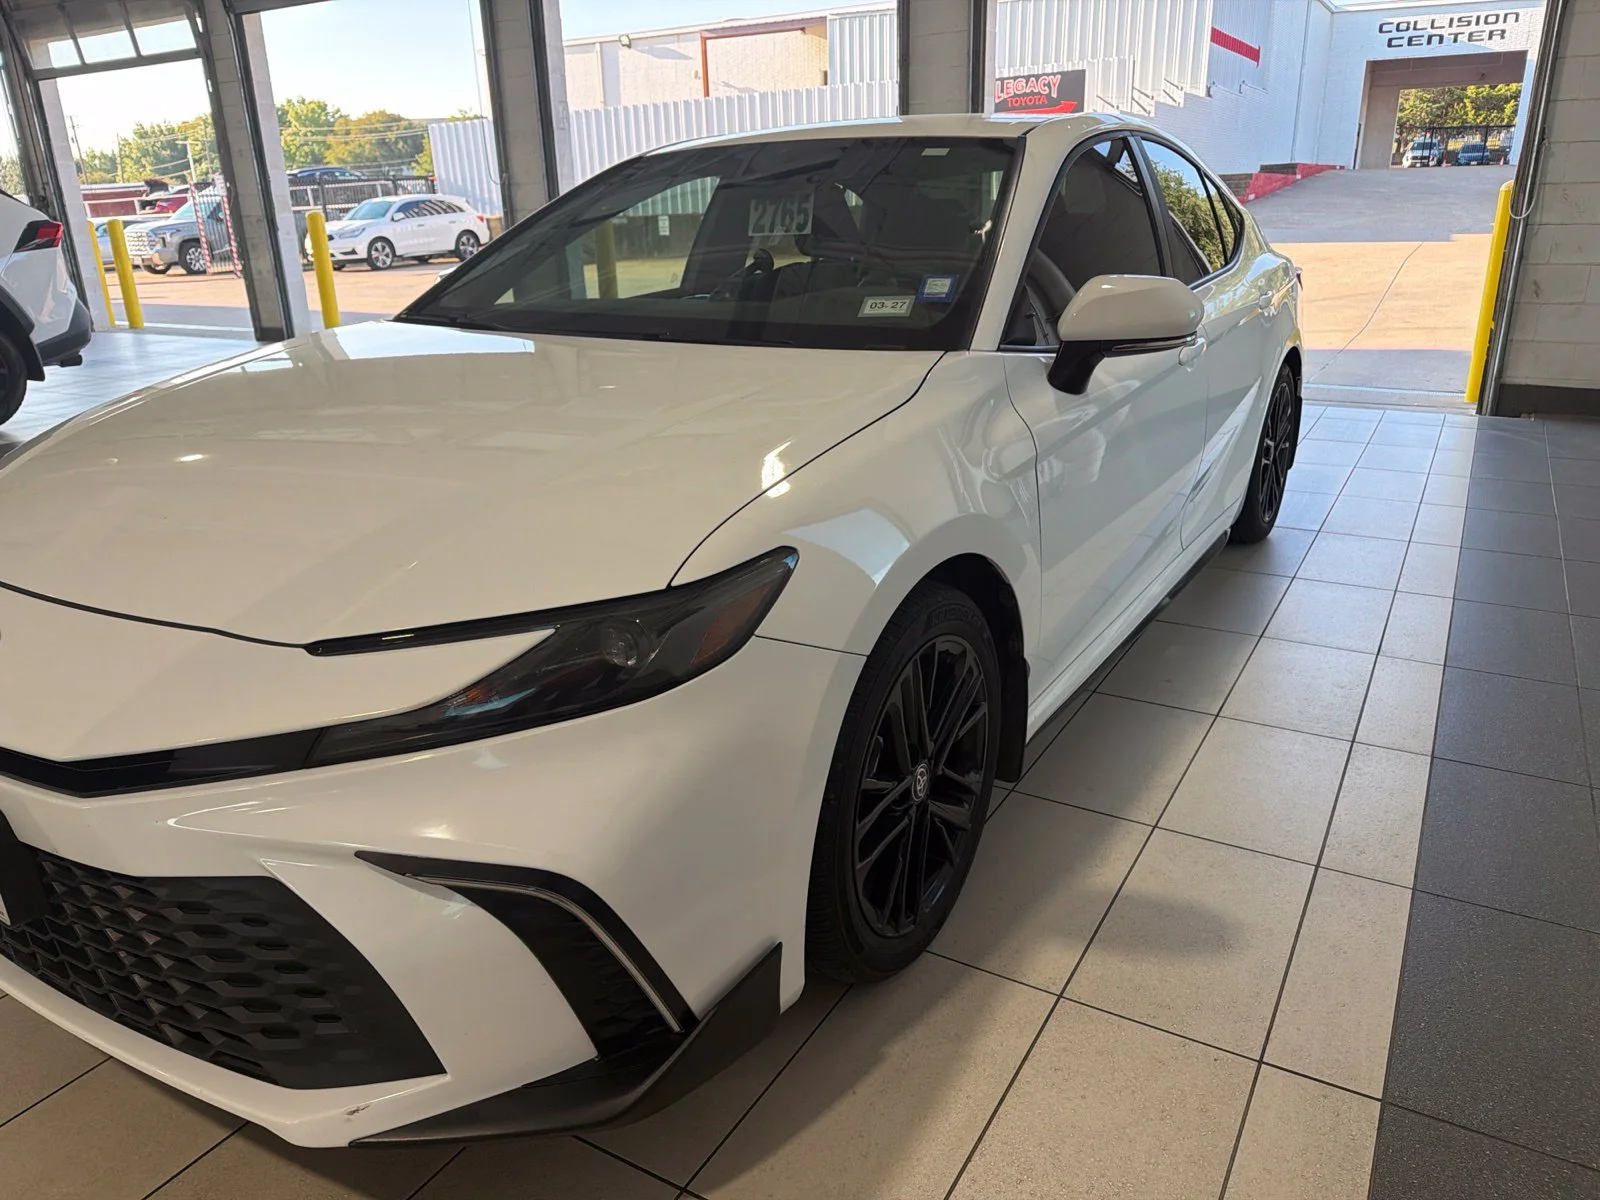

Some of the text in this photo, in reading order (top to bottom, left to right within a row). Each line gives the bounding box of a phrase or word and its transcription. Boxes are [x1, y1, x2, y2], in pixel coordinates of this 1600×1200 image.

[1378, 11, 1520, 34] COLLISION
[1387, 29, 1507, 48] CENTER
[995, 75, 1061, 103] LEGACY
[1007, 95, 1047, 107] TOYOTA
[751, 194, 810, 233] 2765
